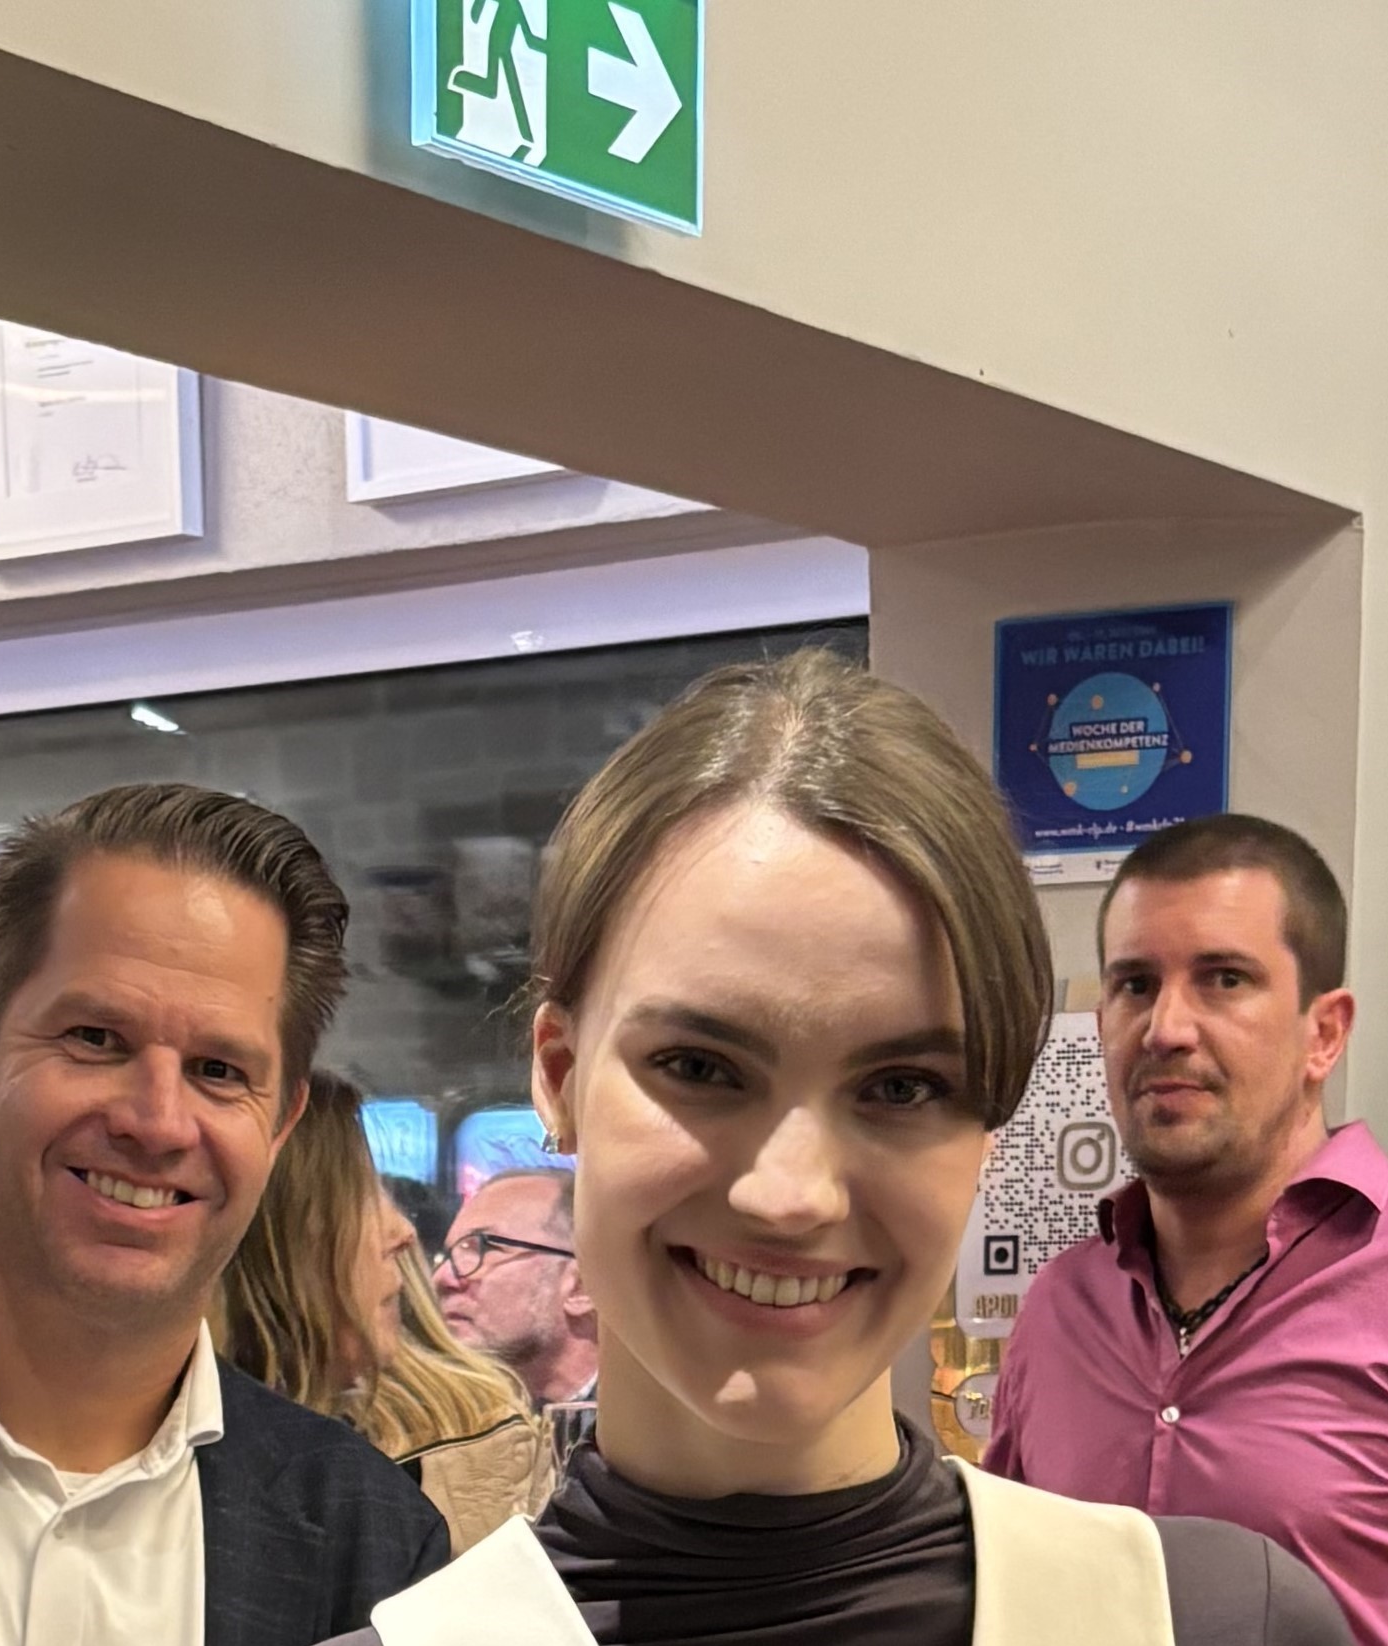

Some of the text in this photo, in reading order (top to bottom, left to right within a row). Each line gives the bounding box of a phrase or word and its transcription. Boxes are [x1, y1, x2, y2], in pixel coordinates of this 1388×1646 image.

[1020, 635, 1205, 666] WIR WAREN DABEI!
[1071, 720, 1145, 737] WOCHE DER
[1048, 734, 1169, 754] MEDIENKOMPETENZ
